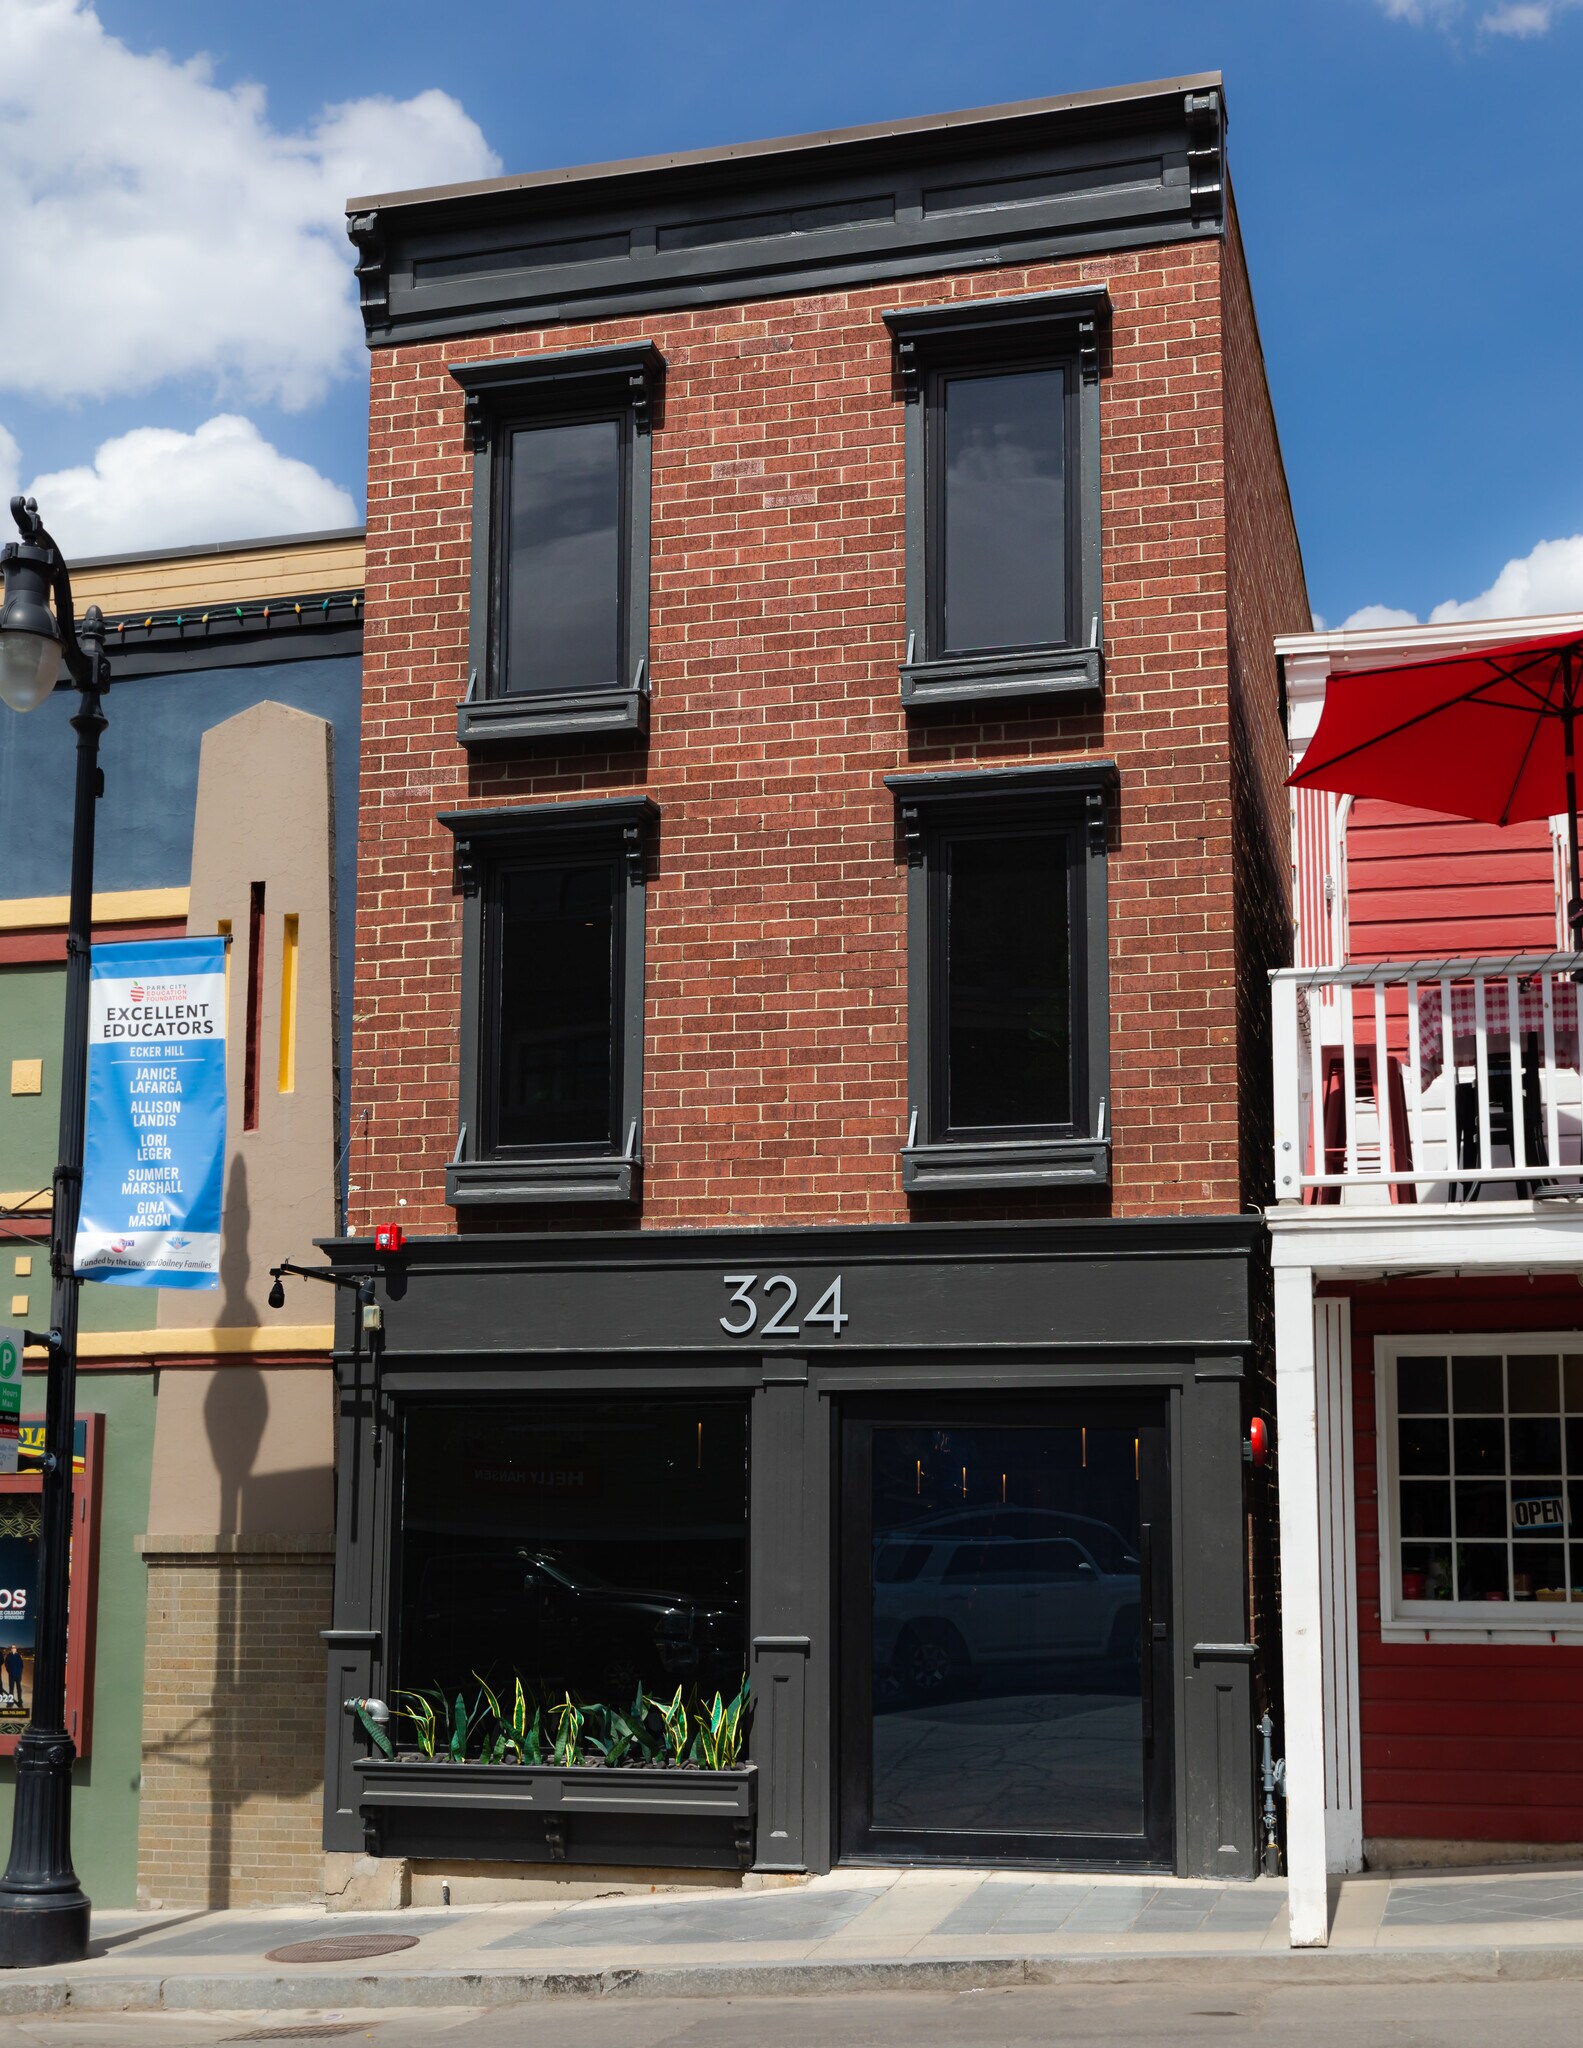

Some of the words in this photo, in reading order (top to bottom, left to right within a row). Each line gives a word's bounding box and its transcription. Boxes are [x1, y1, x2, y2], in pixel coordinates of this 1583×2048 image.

[107, 1003, 209, 1021] EXCELLENT
[103, 1020, 213, 1038] EDUCATORS
[130, 1046, 161, 1057] ECKER
[165, 1045, 184, 1056] HILL
[136, 1067, 177, 1080] JANICE
[130, 1081, 182, 1093] LAFARGA
[130, 1101, 181, 1113] ALLISON
[133, 1114, 177, 1127] LANDIS
[141, 1134, 167, 1147] LORI
[137, 1148, 171, 1161] LEGER
[128, 1167, 179, 1181] SUMMER
[121, 1180, 183, 1195] MARSHALL
[137, 1201, 165, 1214] GINA
[128, 1214, 171, 1227] MASON
[81, 1257, 106, 1267] Funded
[107, 1257, 114, 1265] by
[184, 1260, 211, 1268] Families
[719, 1274, 849, 1334] 324
[3, 1349, 12, 1371] P
[3, 1388, 18, 1397] Hours
[2, 1399, 13, 1408] Max
[1515, 1500, 1564, 1525] OPEN
